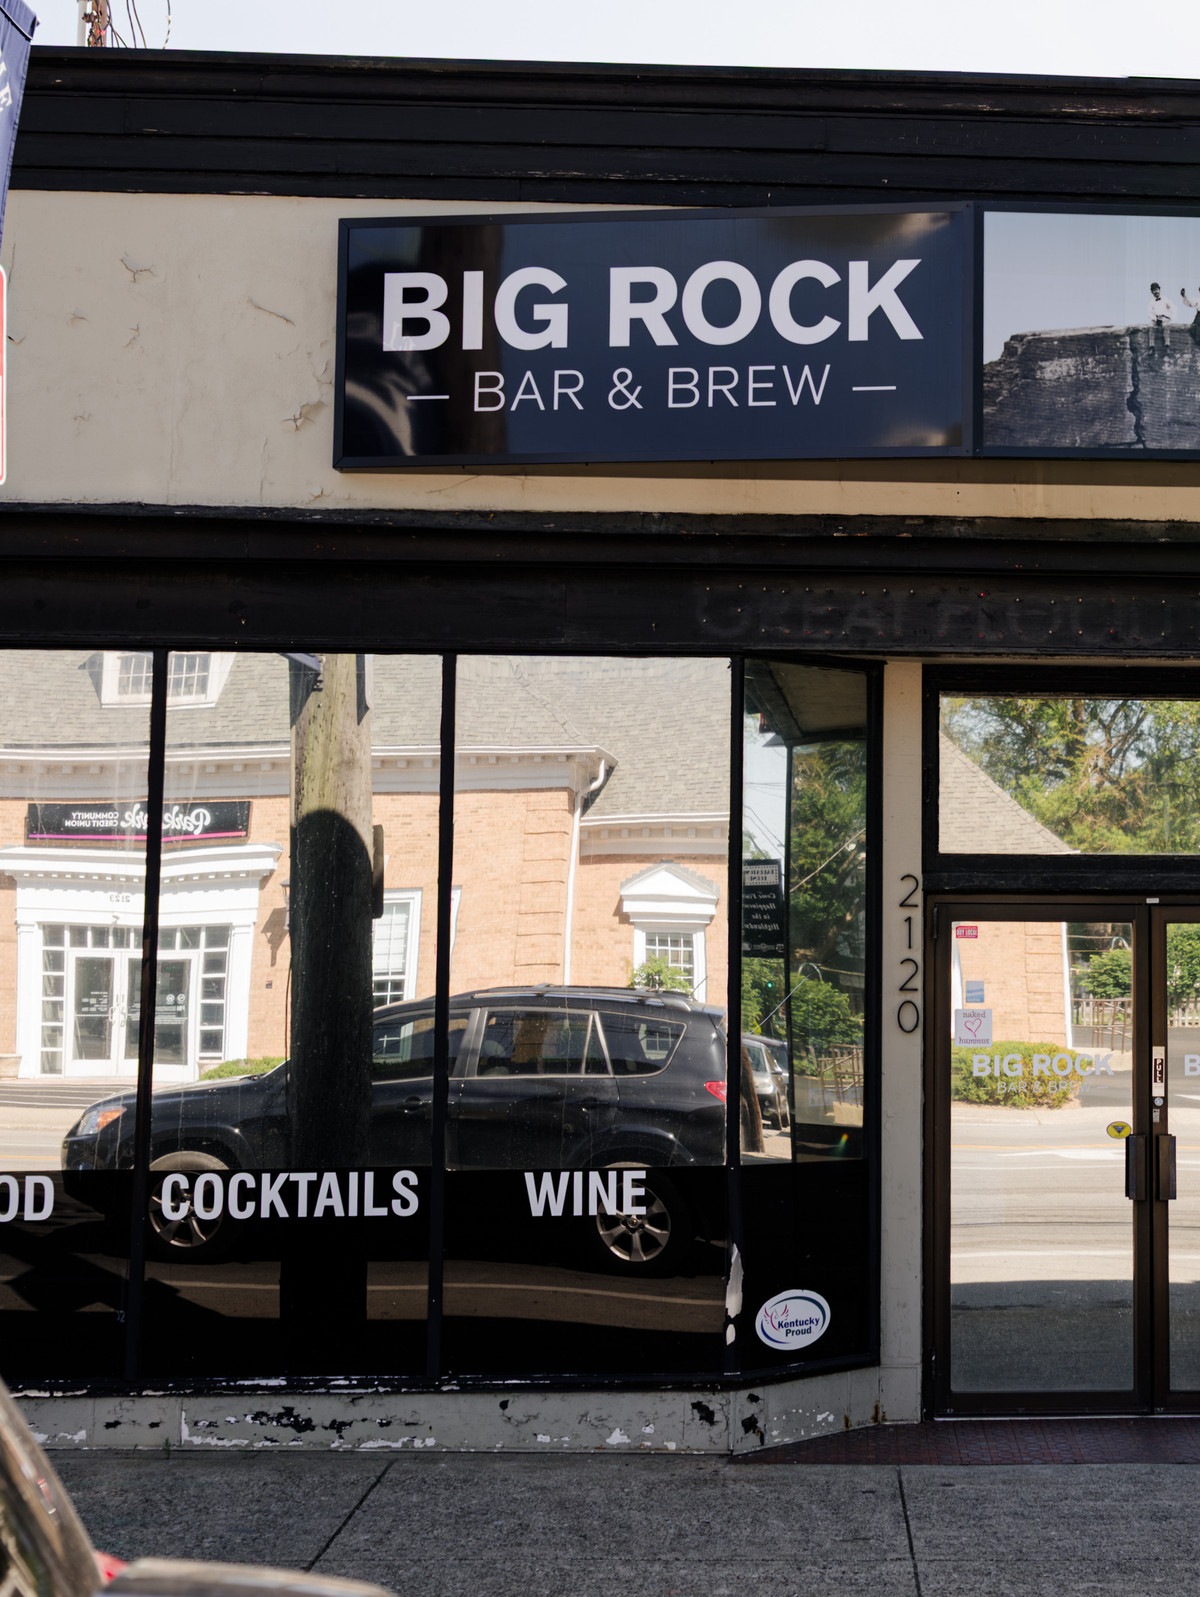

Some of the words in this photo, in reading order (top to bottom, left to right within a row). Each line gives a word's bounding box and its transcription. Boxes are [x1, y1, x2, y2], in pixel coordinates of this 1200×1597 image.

[382, 266, 569, 352] BIG
[608, 259, 925, 348] ROCK
[473, 368, 585, 413] BAR
[607, 367, 644, 411] &
[667, 364, 831, 409] BREW
[897, 874, 919, 1033] 2120
[963, 1010, 986, 1019] naked
[958, 1036, 990, 1045] hummus
[972, 1053, 1023, 1077] BIG
[1032, 1053, 1115, 1077] ROCK
[997, 1081, 1028, 1093] BAR
[1032, 1080, 1043, 1093] &
[1048, 1080, 1091, 1093] BREW
[161, 1170, 420, 1221] COCKTAILS
[523, 1170, 647, 1217] WINE
[777, 1317, 820, 1329] Kentucky
[785, 1326, 812, 1337] Proud
